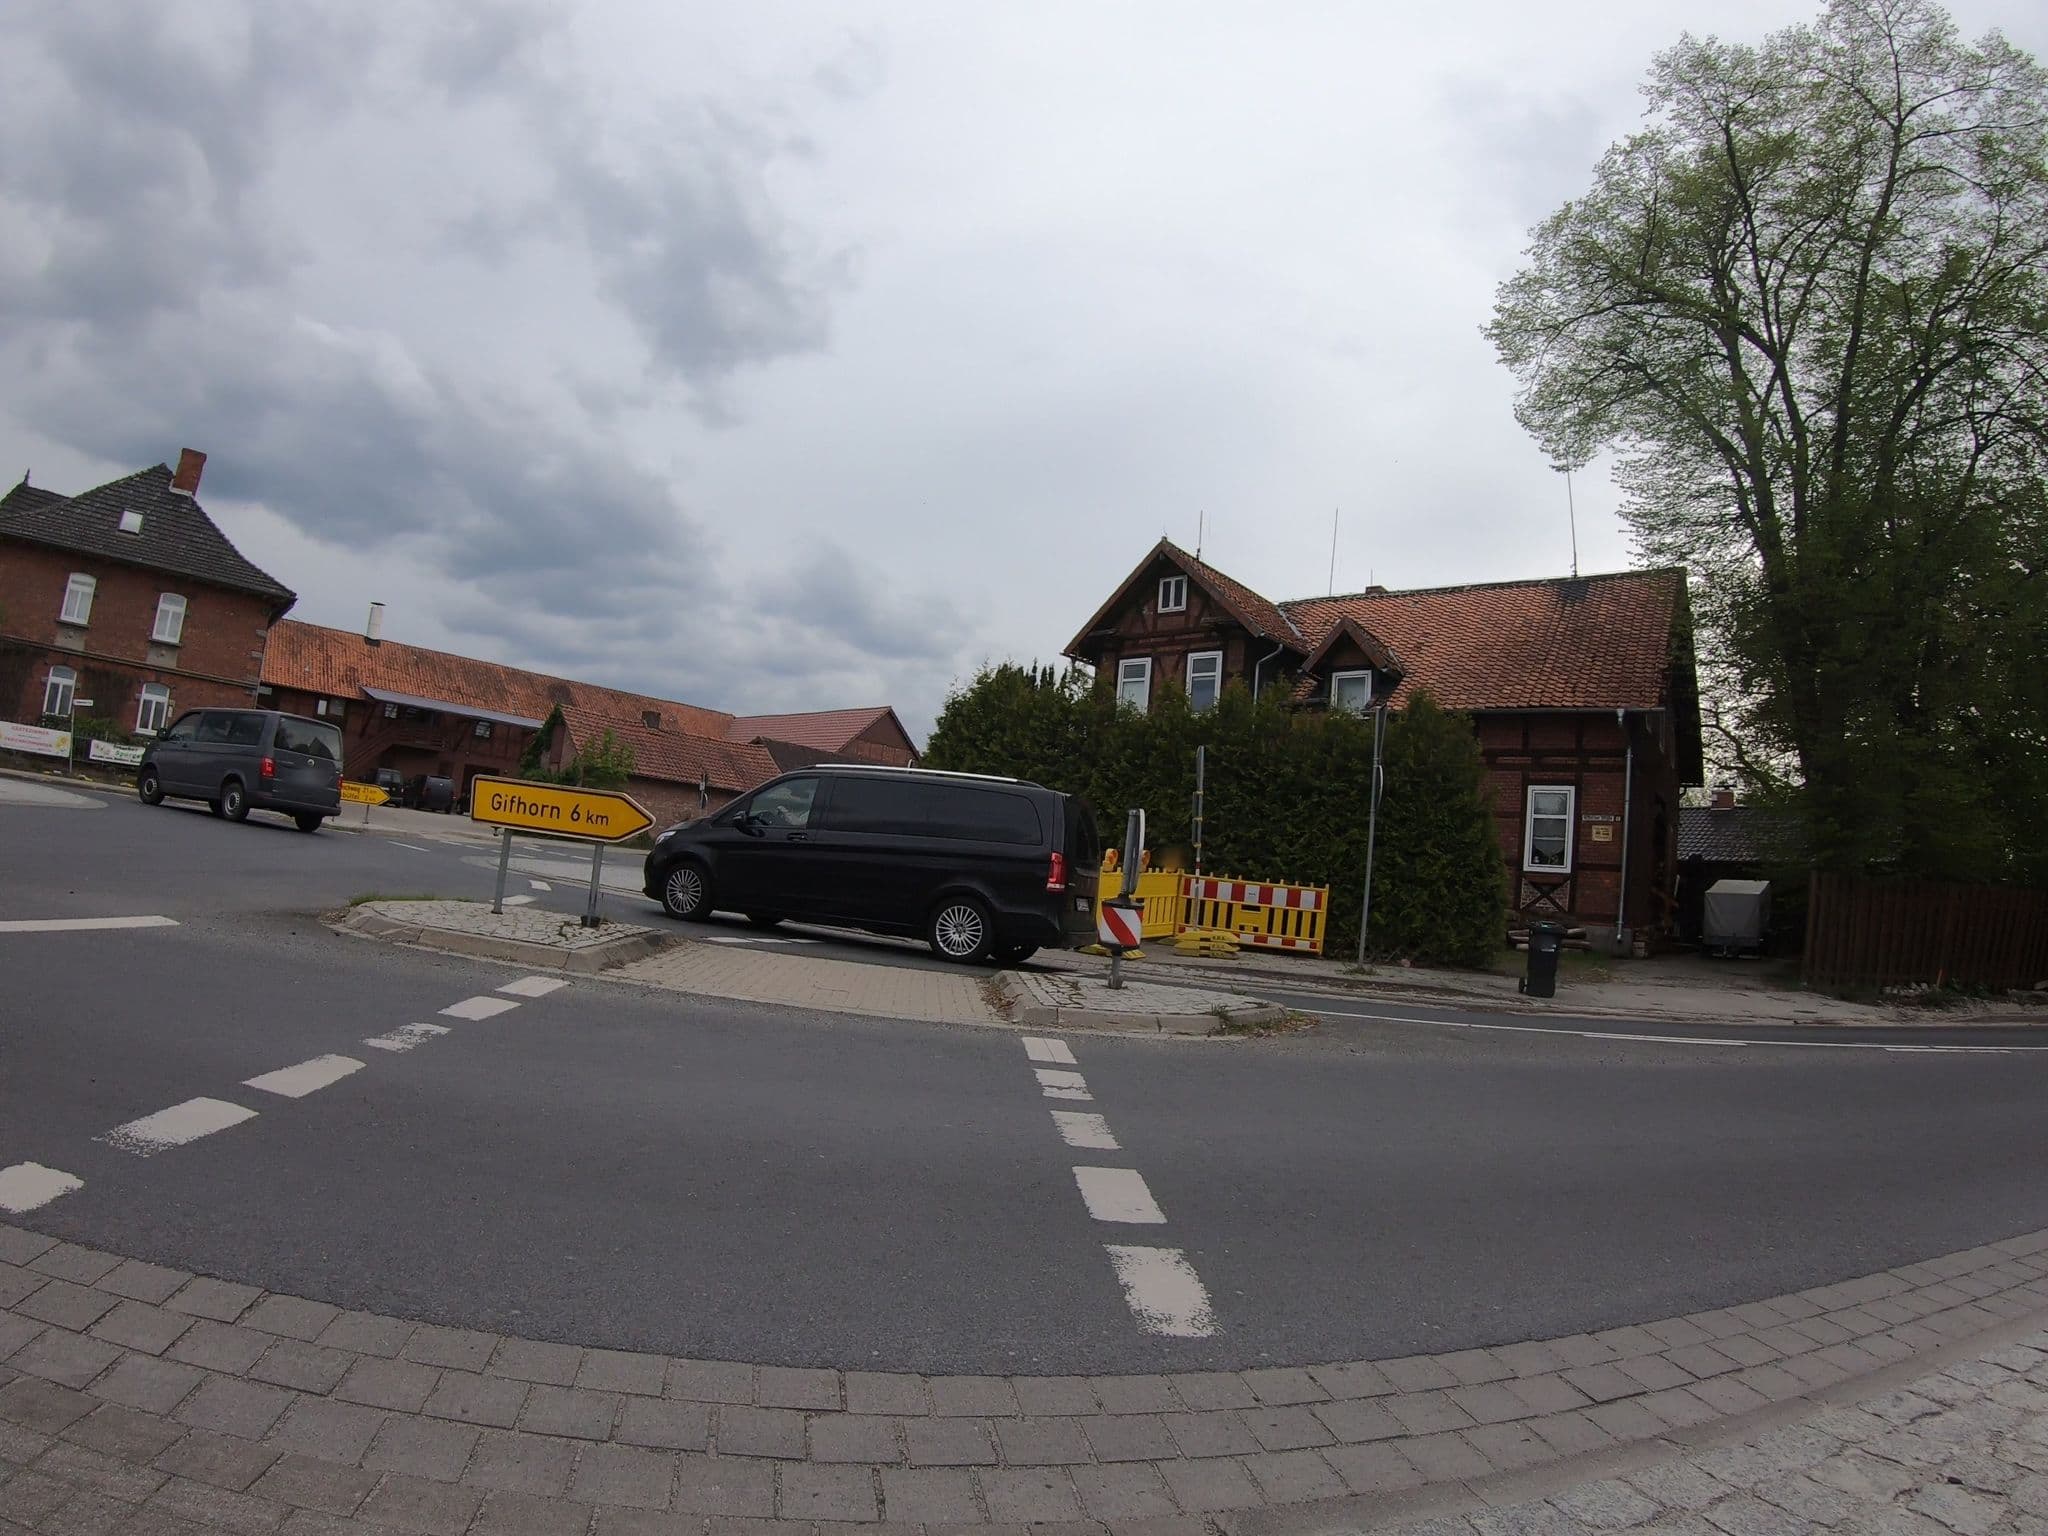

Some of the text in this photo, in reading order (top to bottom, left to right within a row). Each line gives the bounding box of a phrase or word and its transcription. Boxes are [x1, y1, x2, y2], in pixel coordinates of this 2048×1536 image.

[491, 793, 609, 826] Gifhorn 6 km
